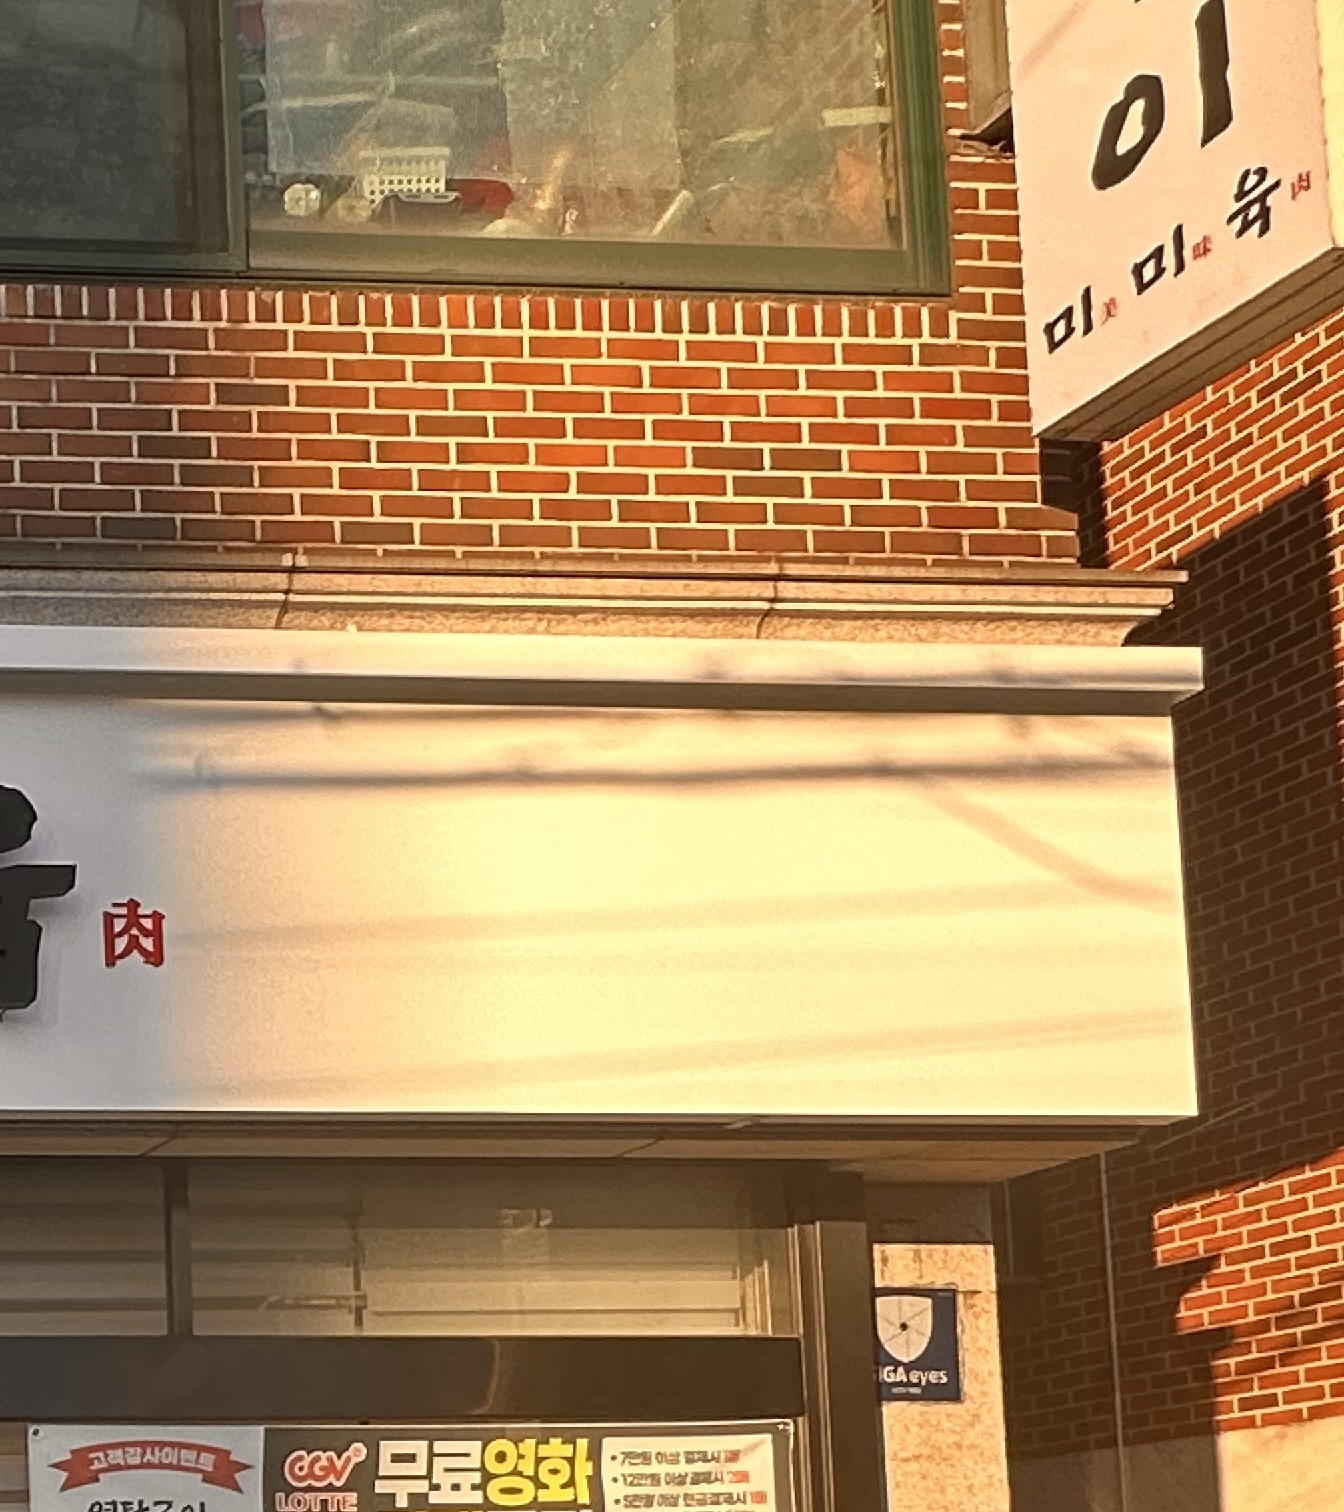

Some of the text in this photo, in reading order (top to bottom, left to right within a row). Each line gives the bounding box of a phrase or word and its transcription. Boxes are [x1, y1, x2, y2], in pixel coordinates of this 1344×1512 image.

[1043, 285, 1093, 354] 미
[1131, 223, 1185, 295] 미
[1226, 166, 1281, 239] 육
[102, 898, 165, 967] 肉
[909, 1369, 948, 1386] eyes
[88, 1446, 216, 1472] 고객감사이벤트
[285, 1447, 358, 1487] CGV
[374, 1437, 594, 1508] 무료영화
[275, 1492, 358, 1512] LOTTE
